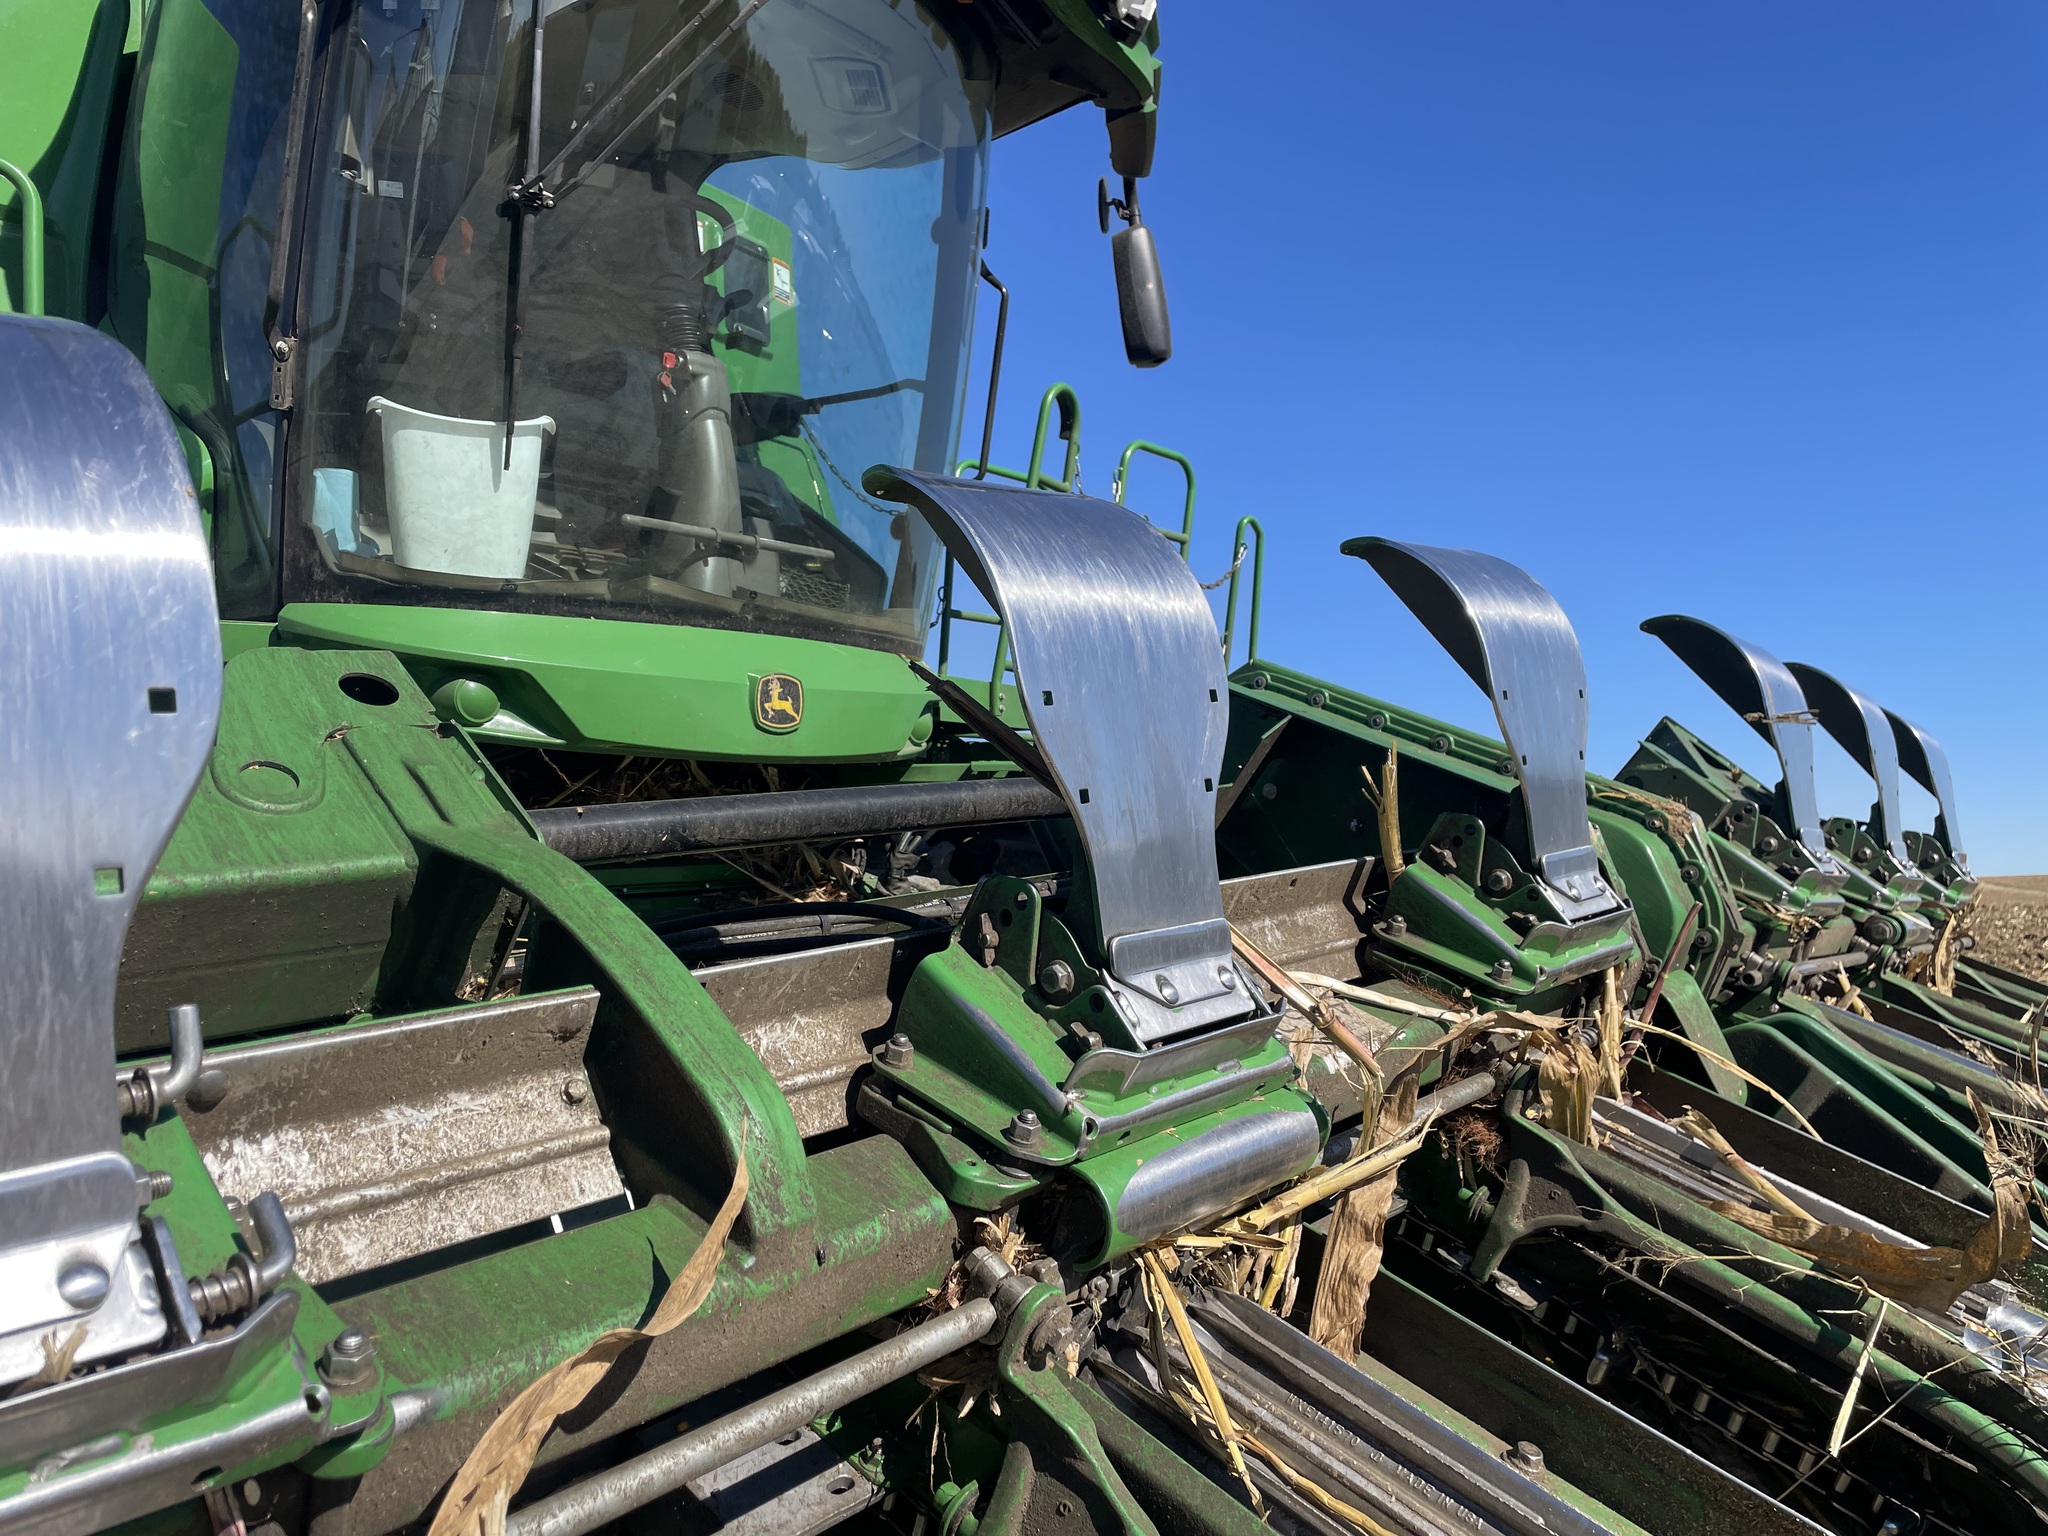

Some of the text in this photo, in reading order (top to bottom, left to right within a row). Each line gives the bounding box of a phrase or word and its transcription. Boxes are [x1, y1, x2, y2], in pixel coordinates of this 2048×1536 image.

[1396, 1464, 1436, 1498] MADE
[1438, 1493, 1455, 1510] IN
[1457, 1505, 1484, 1531] USA
